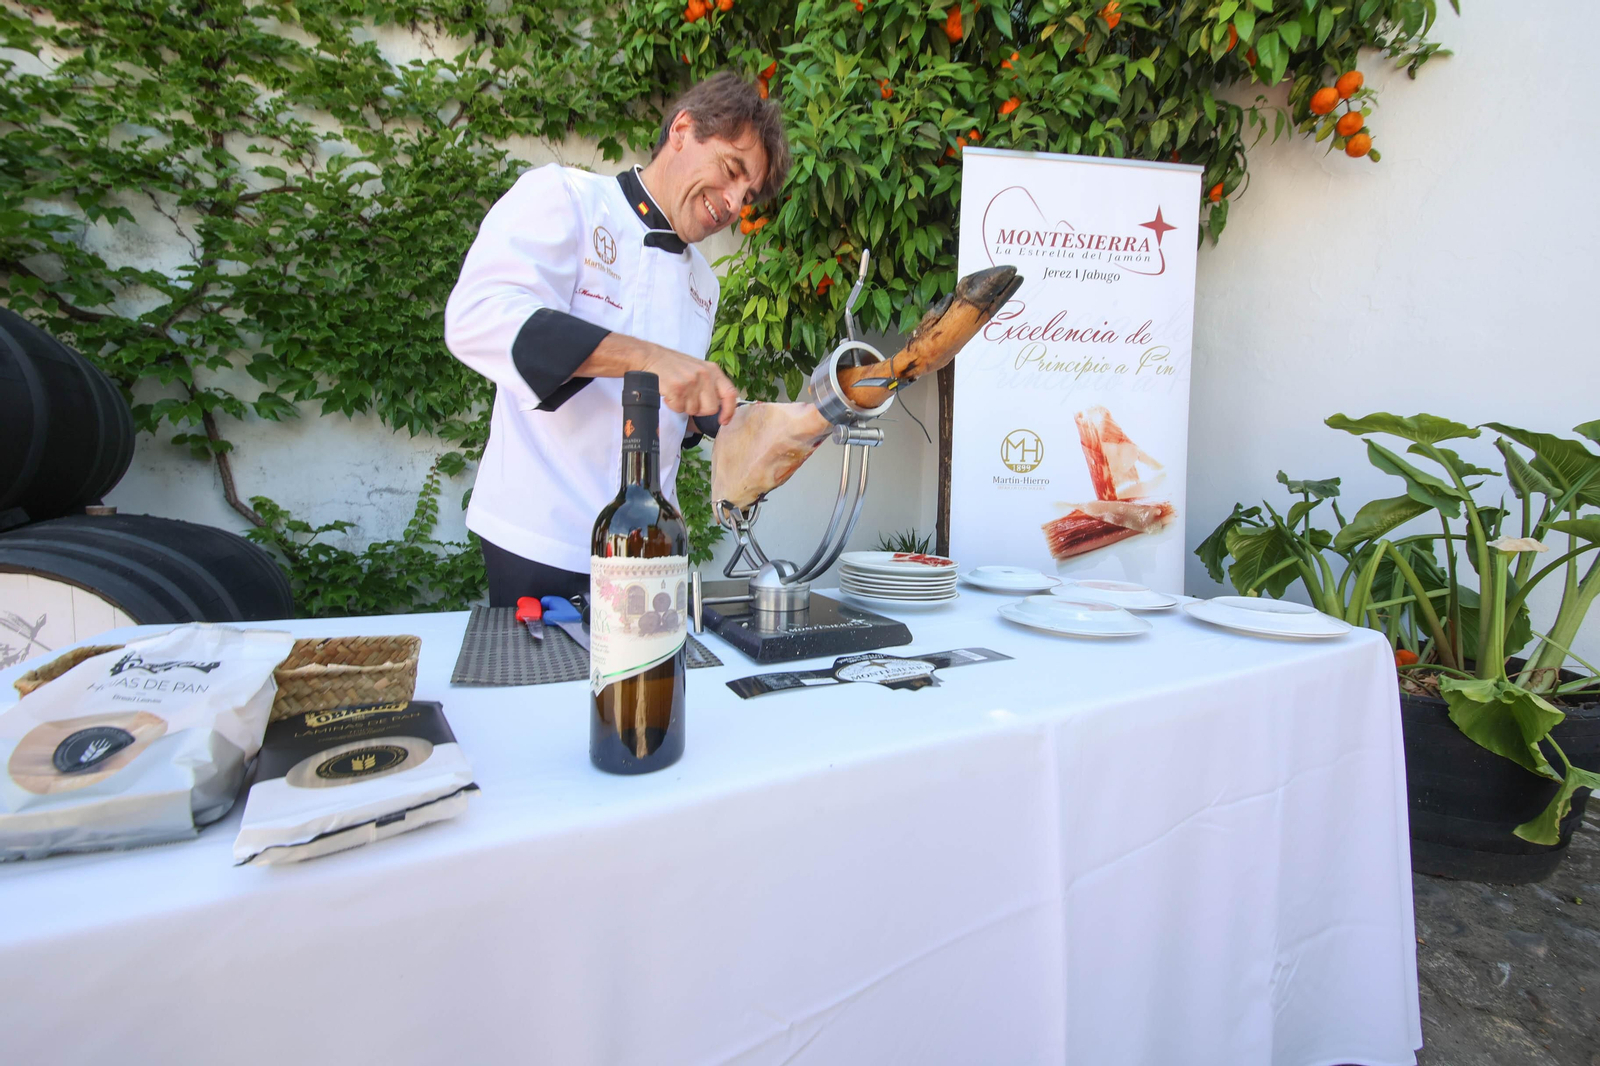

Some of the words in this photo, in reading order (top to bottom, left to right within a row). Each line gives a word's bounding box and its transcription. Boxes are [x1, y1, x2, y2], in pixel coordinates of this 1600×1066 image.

[996, 228, 1151, 252] MONTESIERRA
[995, 246, 1011, 255] La
[1019, 247, 1075, 259] Estrella
[1082, 250, 1102, 260] del
[1107, 252, 1151, 263] Jamón
[1042, 267, 1072, 280] Jerez
[1080, 269, 1121, 284] Jabugo
[983, 300, 1119, 344] Excelencia
[1124, 319, 1153, 345] de
[1014, 341, 1111, 381] Principio
[1114, 363, 1129, 374] a
[1135, 345, 1176, 376] Fin
[1004, 437, 1041, 463] MH
[1012, 464, 1031, 472] 1899
[851, 664, 932, 681] MONTESIERRA
[87, 677, 139, 692] HAS
[143, 678, 170, 691] DE
[172, 681, 210, 694] PAN
[367, 717, 388, 726] DE
[391, 712, 420, 721] PAN
